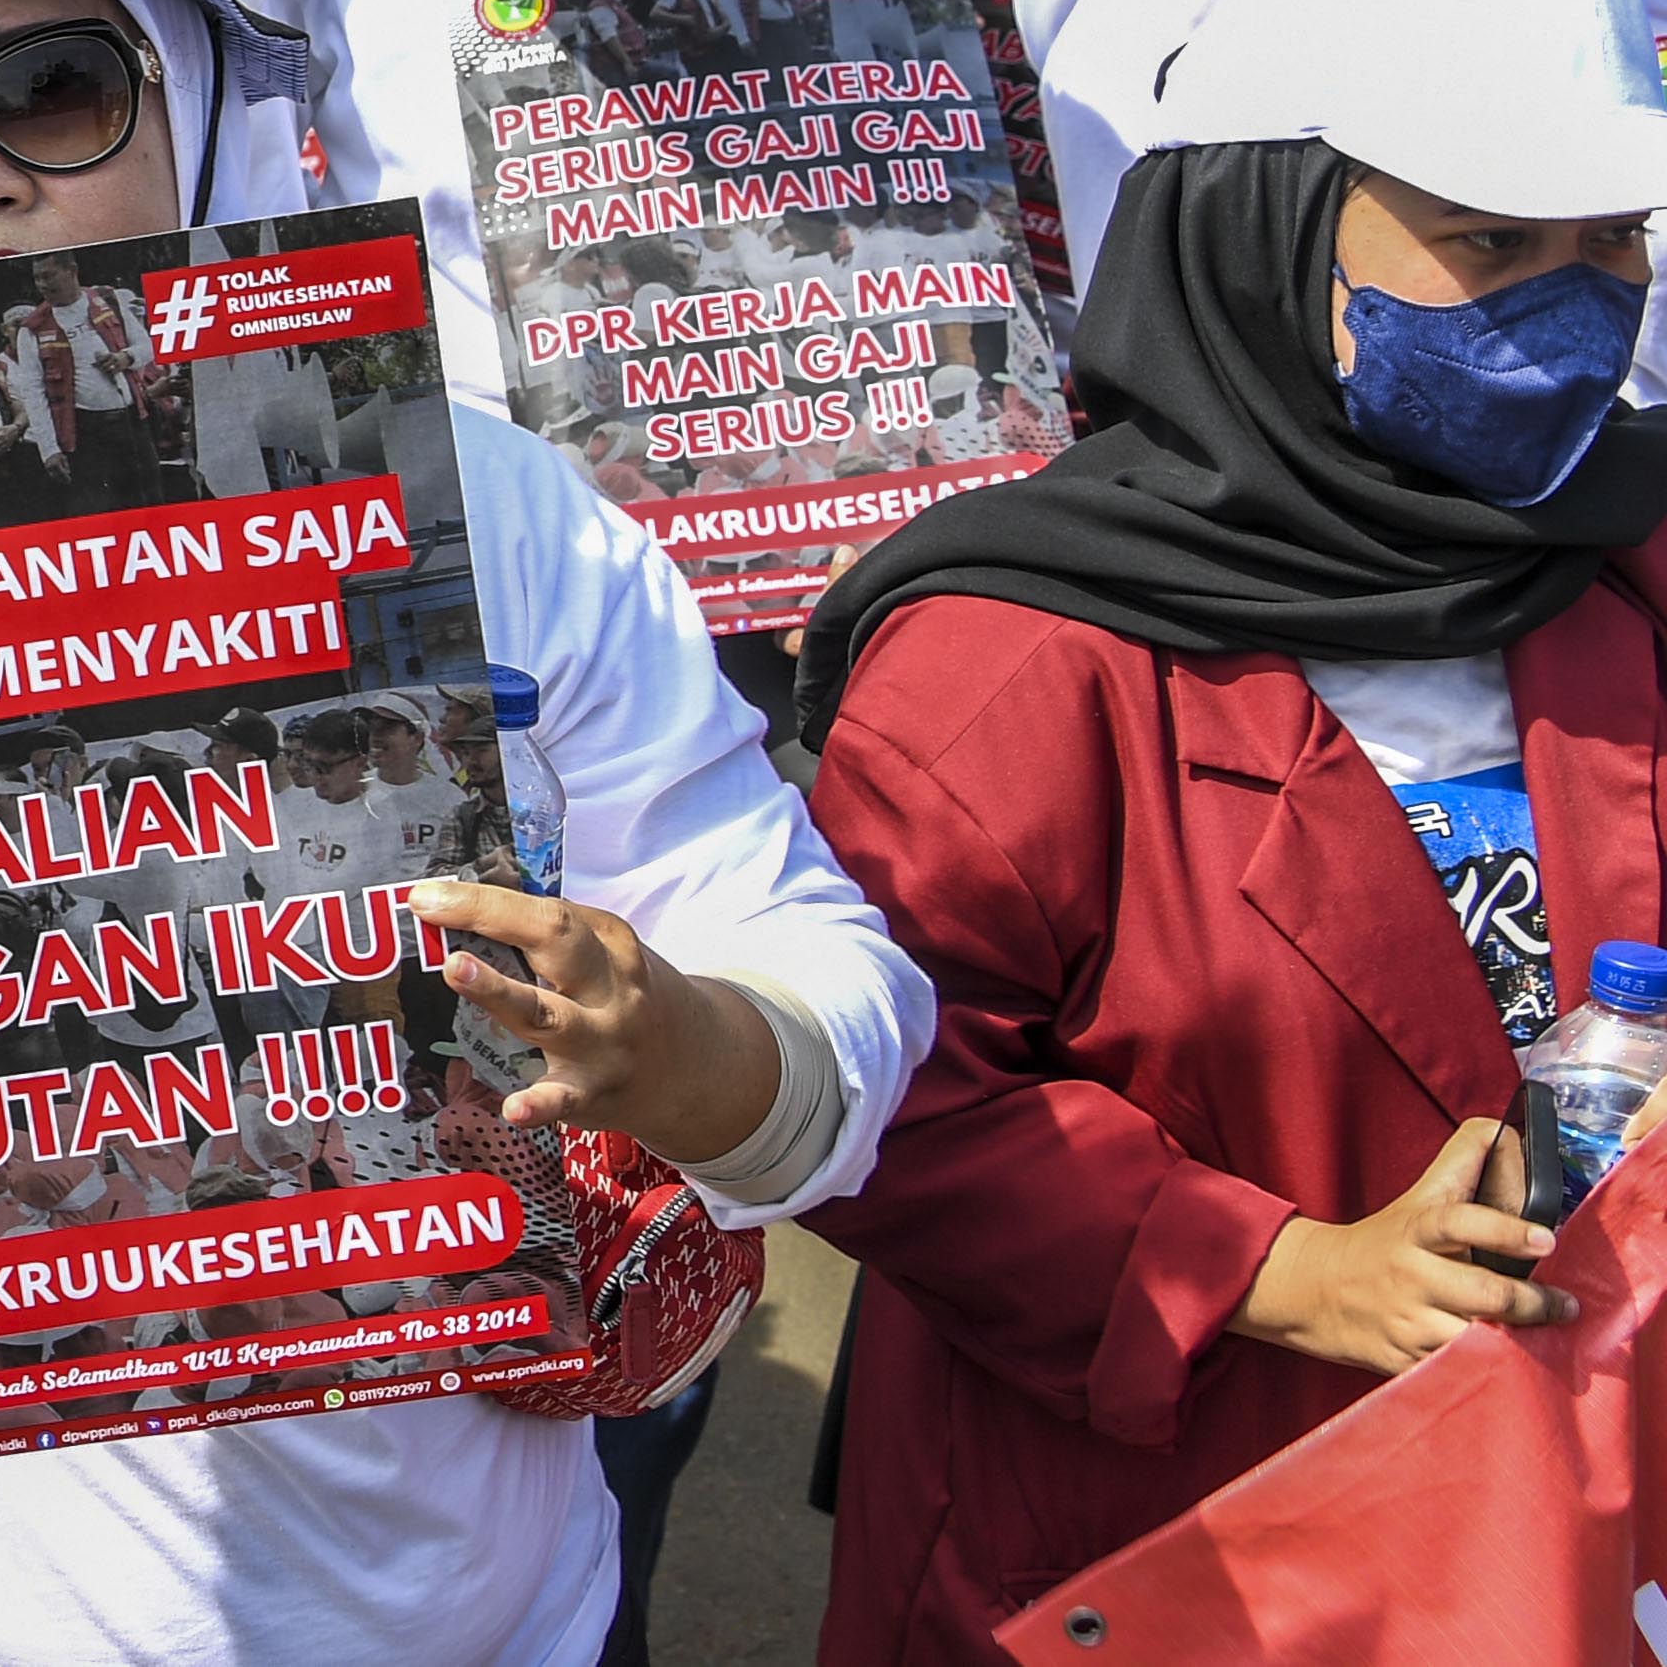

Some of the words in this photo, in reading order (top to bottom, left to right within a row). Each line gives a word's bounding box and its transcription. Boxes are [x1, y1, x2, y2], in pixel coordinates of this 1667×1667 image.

[490, 66, 770, 153] PERAWAT
[787, 58, 971, 108] KERJA
[494, 131, 694, 204] SERIUS
[705, 112, 841, 169] GAJI
[851, 107, 986, 154] GAJI
[545, 182, 703, 252] MAIN
[716, 163, 878, 226] MAIN
[890, 157, 953, 205] !!!
[217, 266, 291, 291] TOLAK
[227, 275, 392, 314] RUUKESEHATAN
[230, 307, 352, 338] OMNIBUSLAW
[523, 306, 651, 368] DPR
[652, 276, 844, 348] KERJA
[852, 262, 1016, 319] MAIN
[621, 340, 786, 408] MAIN
[795, 319, 937, 385] GAJI
[645, 390, 857, 463] SERIUS
[867, 376, 934, 434] !!!
[243, 497, 408, 570] SAJA
[1406, 801, 1452, 838] 국
[256, 1018, 409, 1129] !!!!
[42, 1356, 178, 1391] Selamatkan
[182, 1351, 232, 1372] UU
[237, 1328, 395, 1368] Keperawatan
[399, 1320, 438, 1342] No
[442, 1315, 470, 1334] 38
[475, 1306, 531, 1333] 2014
[61, 1422, 139, 1445] dpwppnidki
[168, 1396, 314, 1431] ppni_dki@yahoo.com
[349, 1381, 431, 1403] 08119292997
[471, 1356, 584, 1384] www.ppnidki.org
